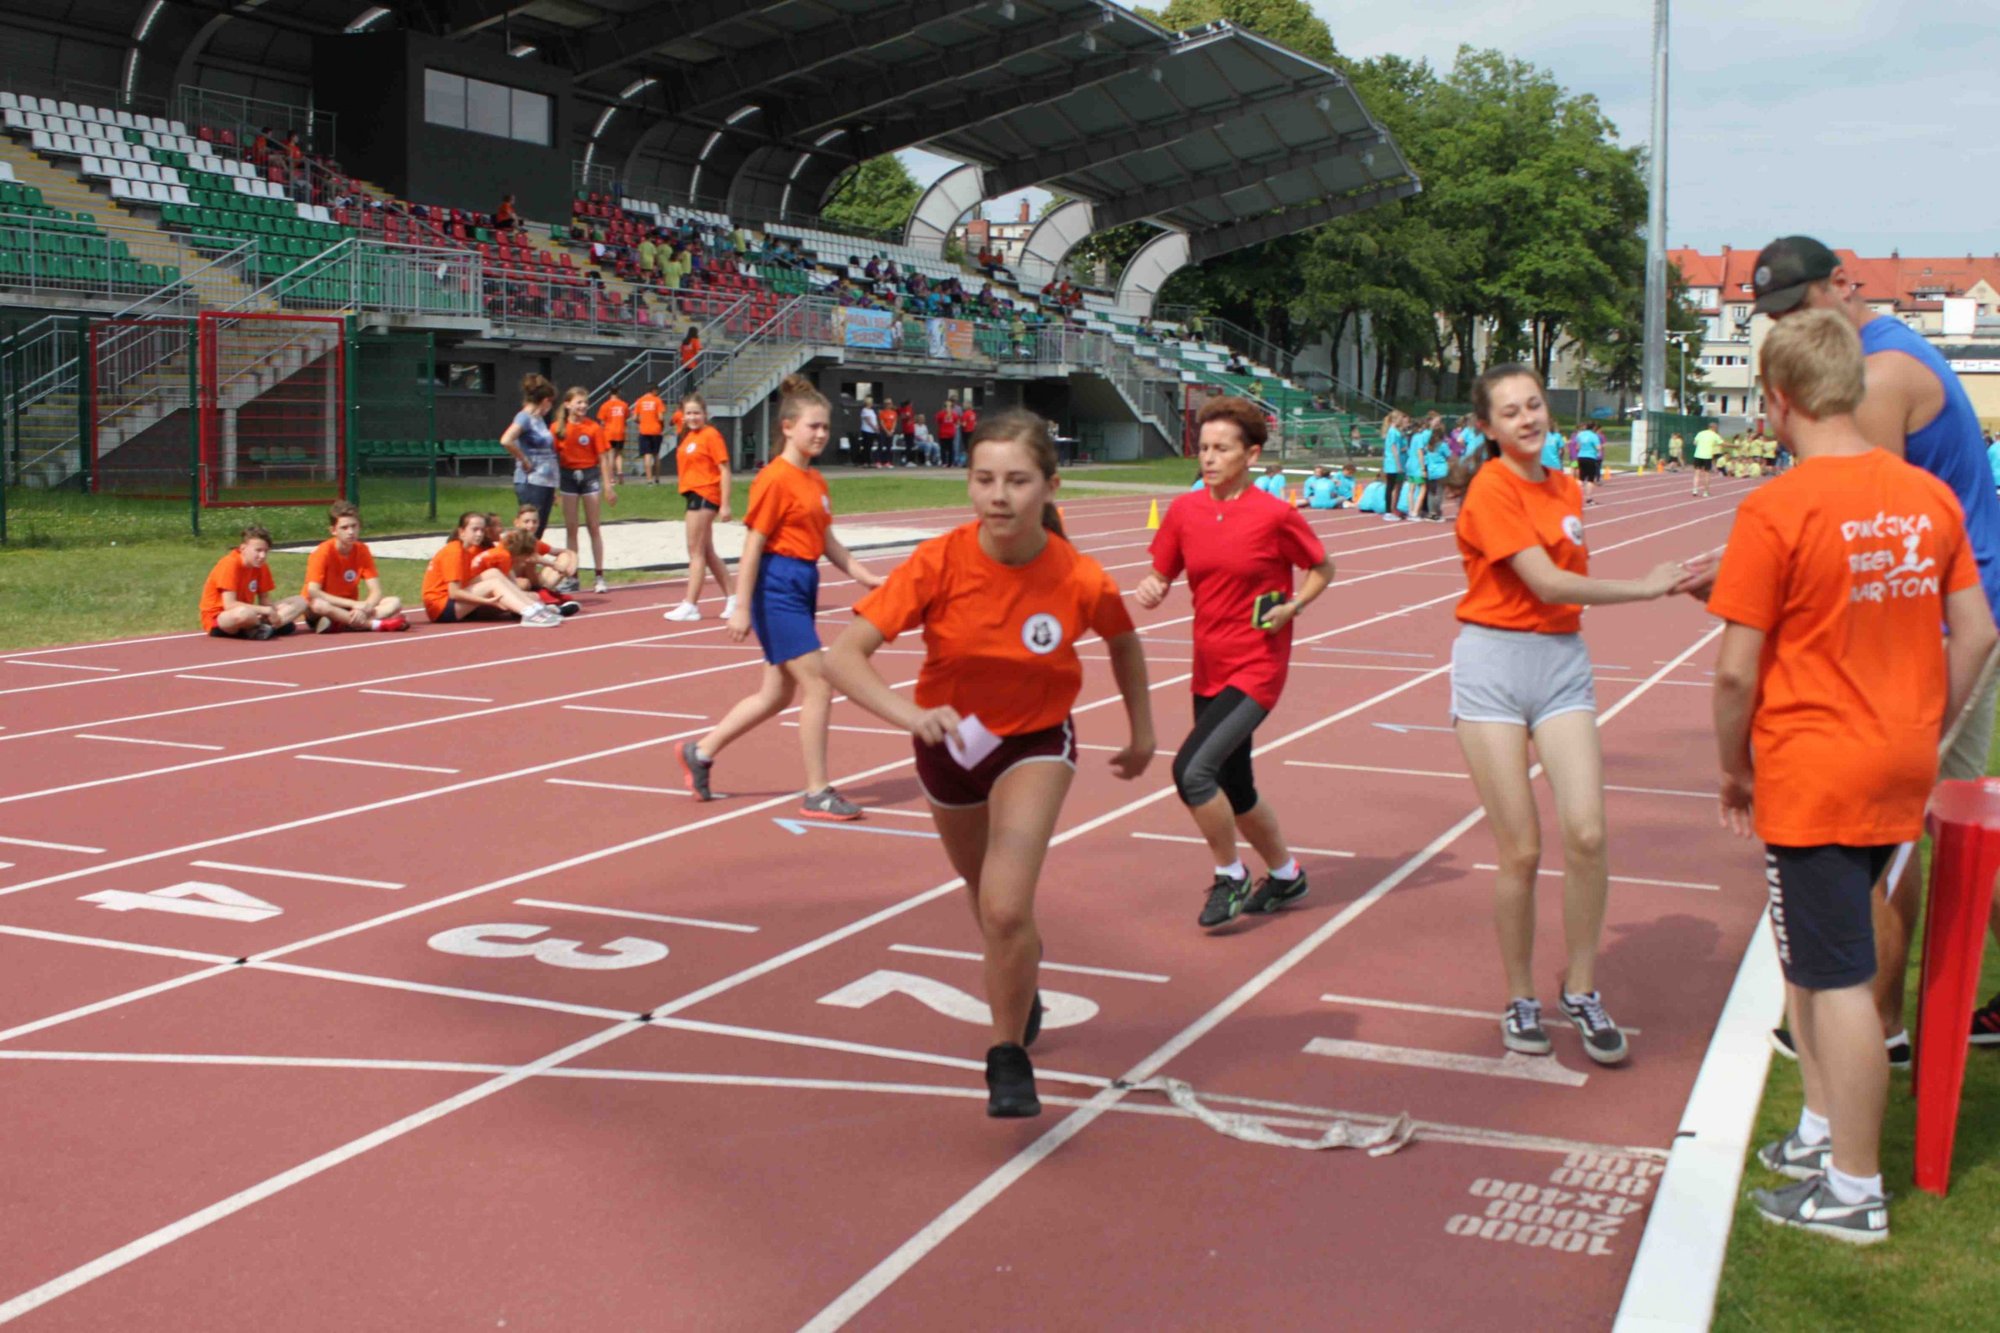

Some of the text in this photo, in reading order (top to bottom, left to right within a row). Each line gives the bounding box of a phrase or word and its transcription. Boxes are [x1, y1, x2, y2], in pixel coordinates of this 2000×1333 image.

[77, 881, 286, 922] 4
[427, 922, 669, 971] 3
[817, 968, 1100, 1029] 2
[1550, 1167, 1651, 1196] 800
[1564, 1151, 1665, 1177] 400
[1469, 1178, 1643, 1215] 4x400
[1444, 1214, 1614, 1256] 10000
[1486, 1199, 1625, 1236] 2000
